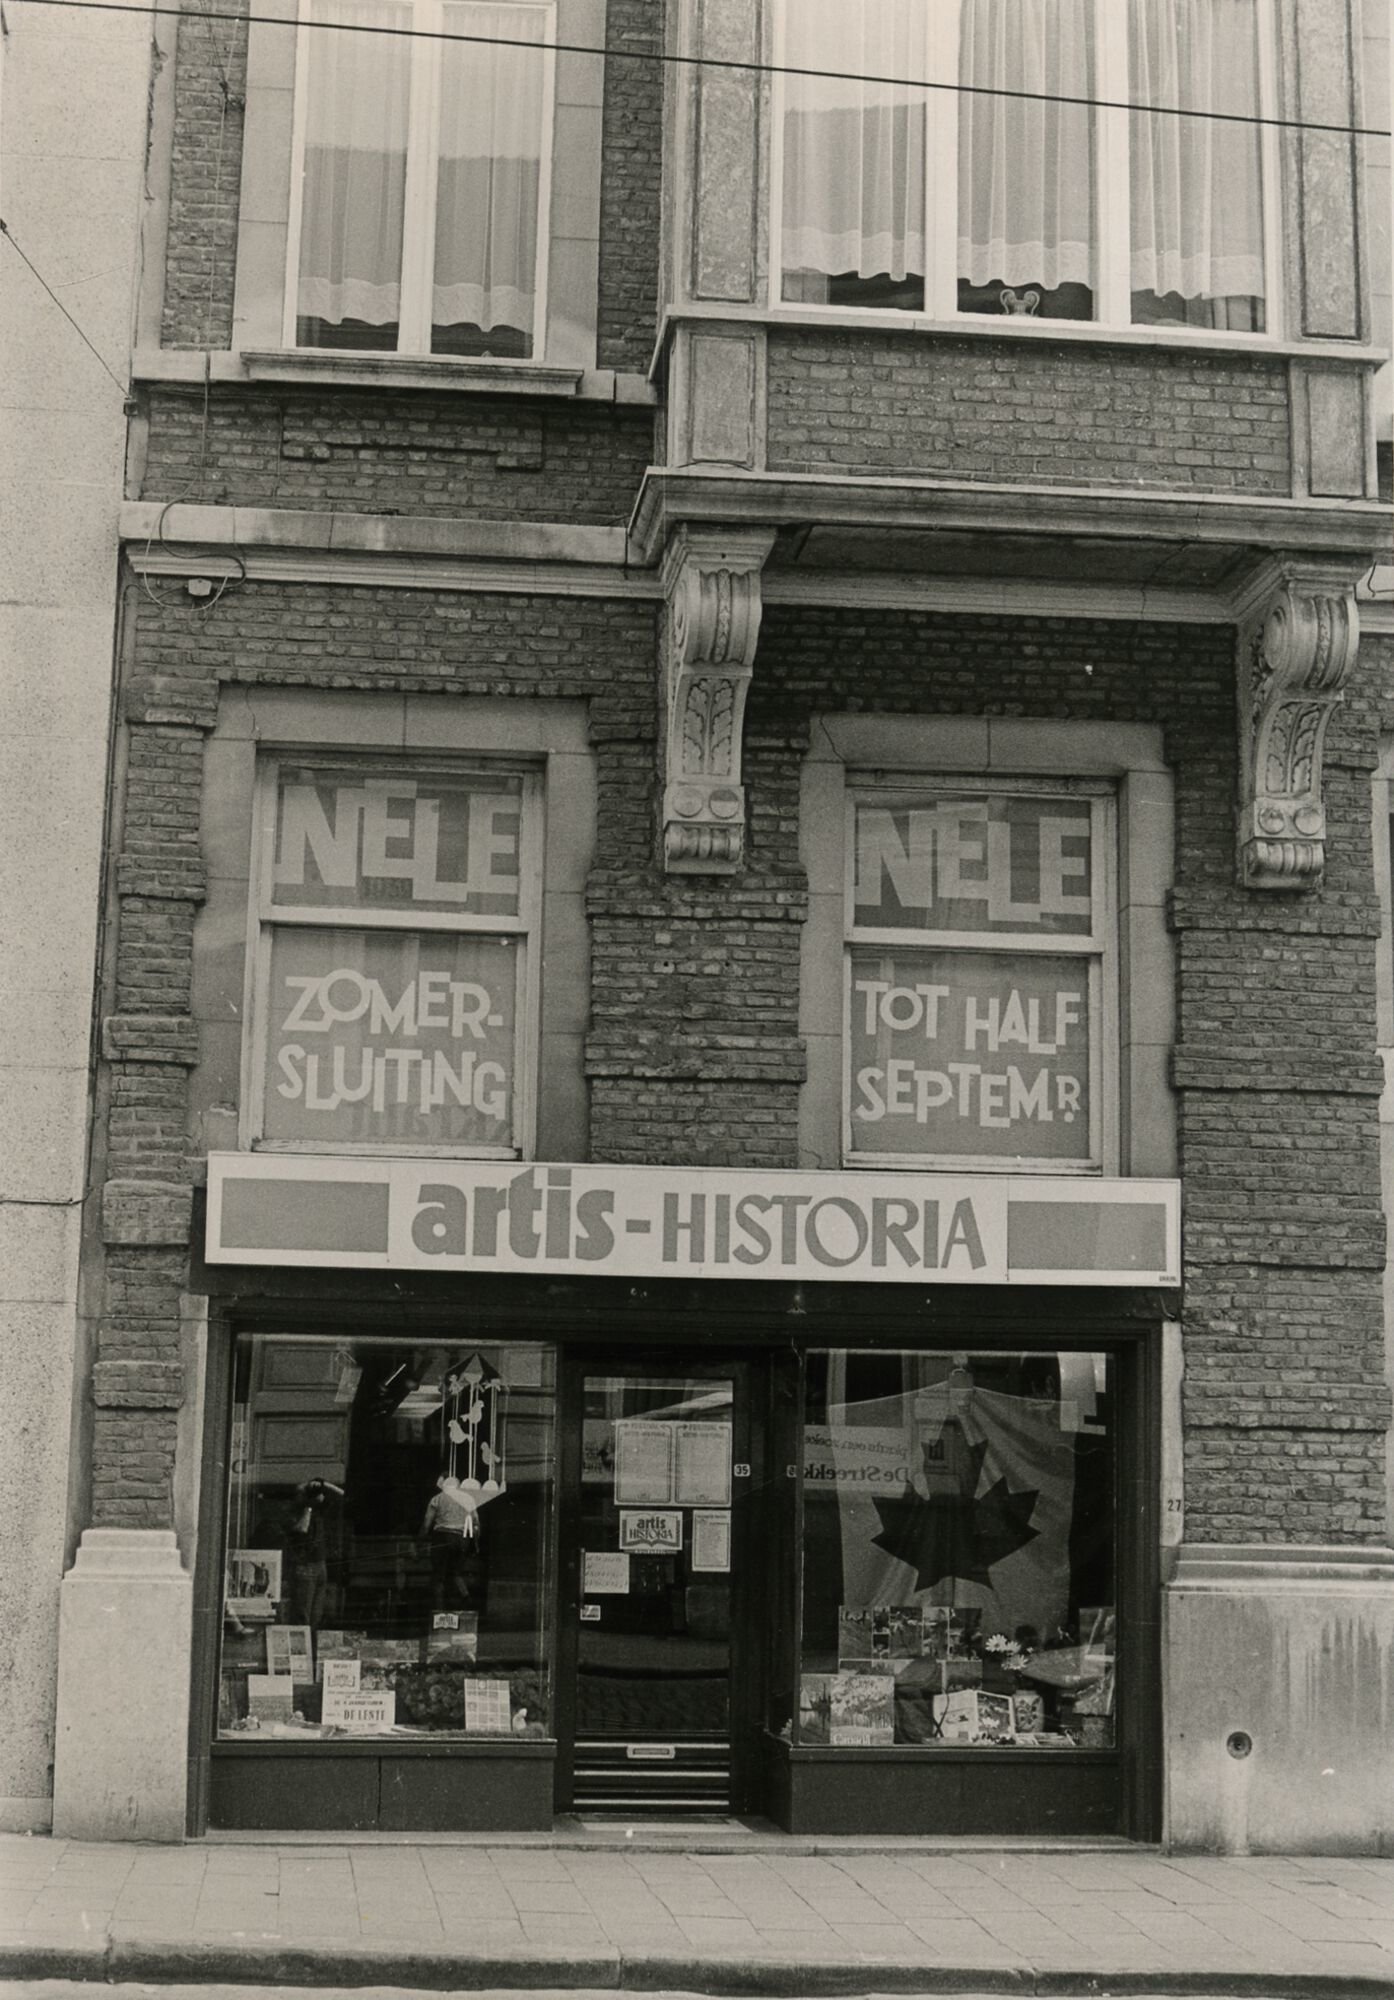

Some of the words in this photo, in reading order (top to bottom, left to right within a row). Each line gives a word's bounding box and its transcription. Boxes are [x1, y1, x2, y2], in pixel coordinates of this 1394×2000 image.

[274, 778, 519, 903] NELE
[854, 801, 1090, 923] NELE
[282, 968, 503, 1039] ZOMER-
[855, 980, 949, 1039] TOT
[965, 988, 1080, 1055] HALF
[276, 1043, 506, 1121] SLUITING
[736, 1465, 749, 1475] 35
[1167, 1499, 1181, 1512] 27
[637, 1516, 666, 1529] artis
